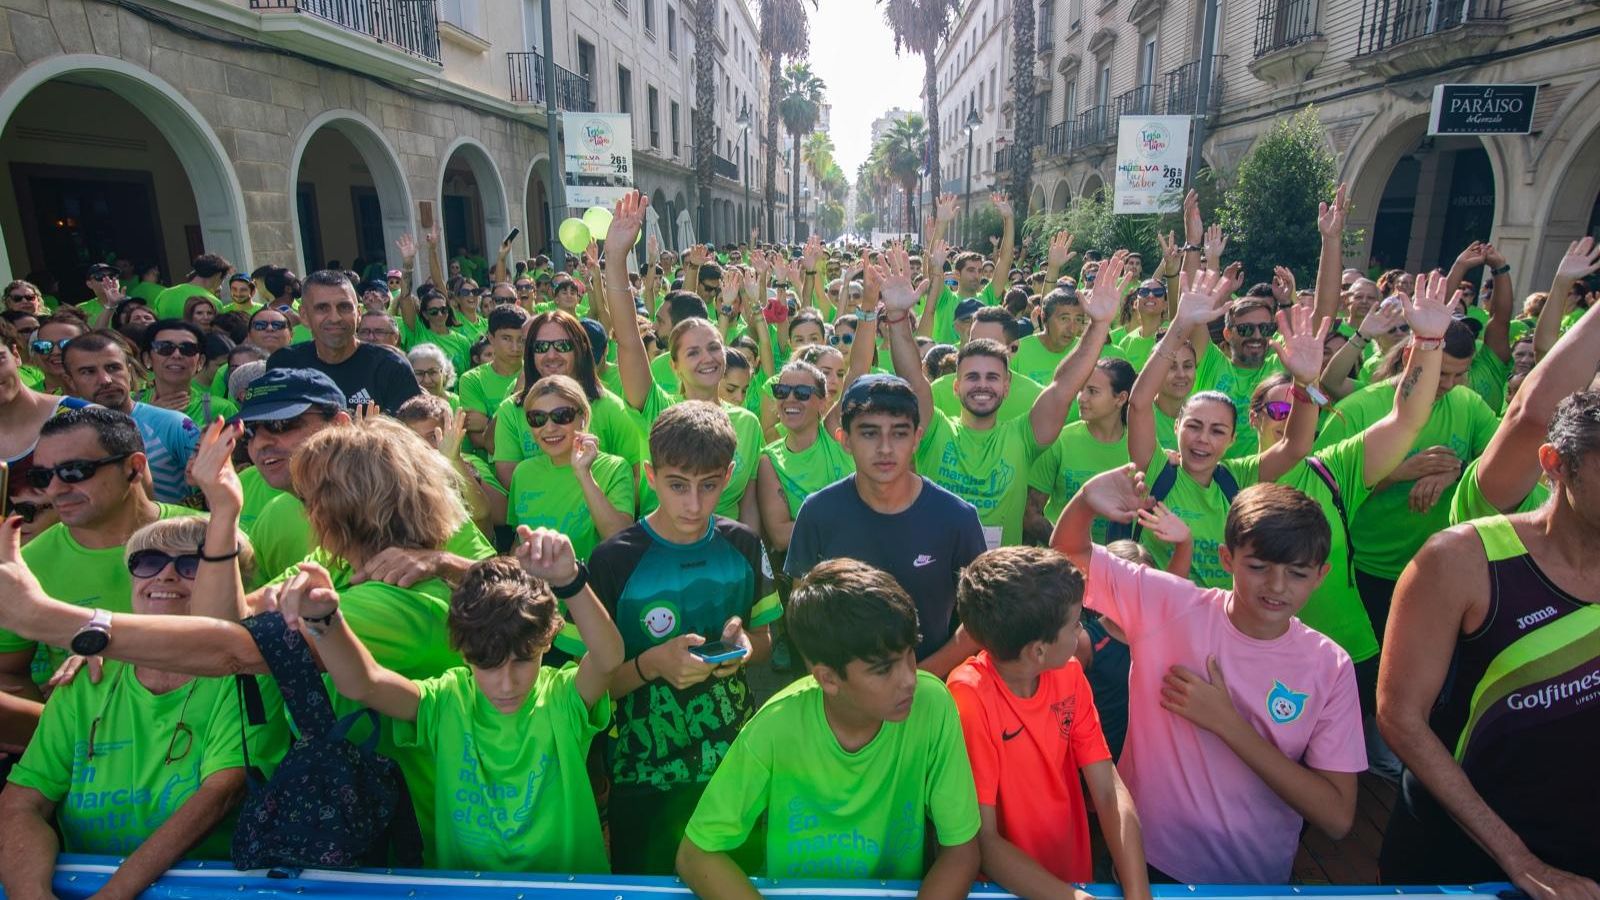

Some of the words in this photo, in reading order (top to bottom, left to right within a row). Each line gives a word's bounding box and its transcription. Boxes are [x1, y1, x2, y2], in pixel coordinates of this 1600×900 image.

[1483, 88, 1494, 98] El
[1450, 98, 1522, 113] PARAISO
[611, 155, 621, 165] 26
[617, 164, 627, 173] 29
[1163, 167, 1176, 178] 26
[1169, 178, 1182, 188] 29
[788, 814, 819, 833] En
[787, 828, 881, 857] marcha
[787, 856, 868, 877] contra
